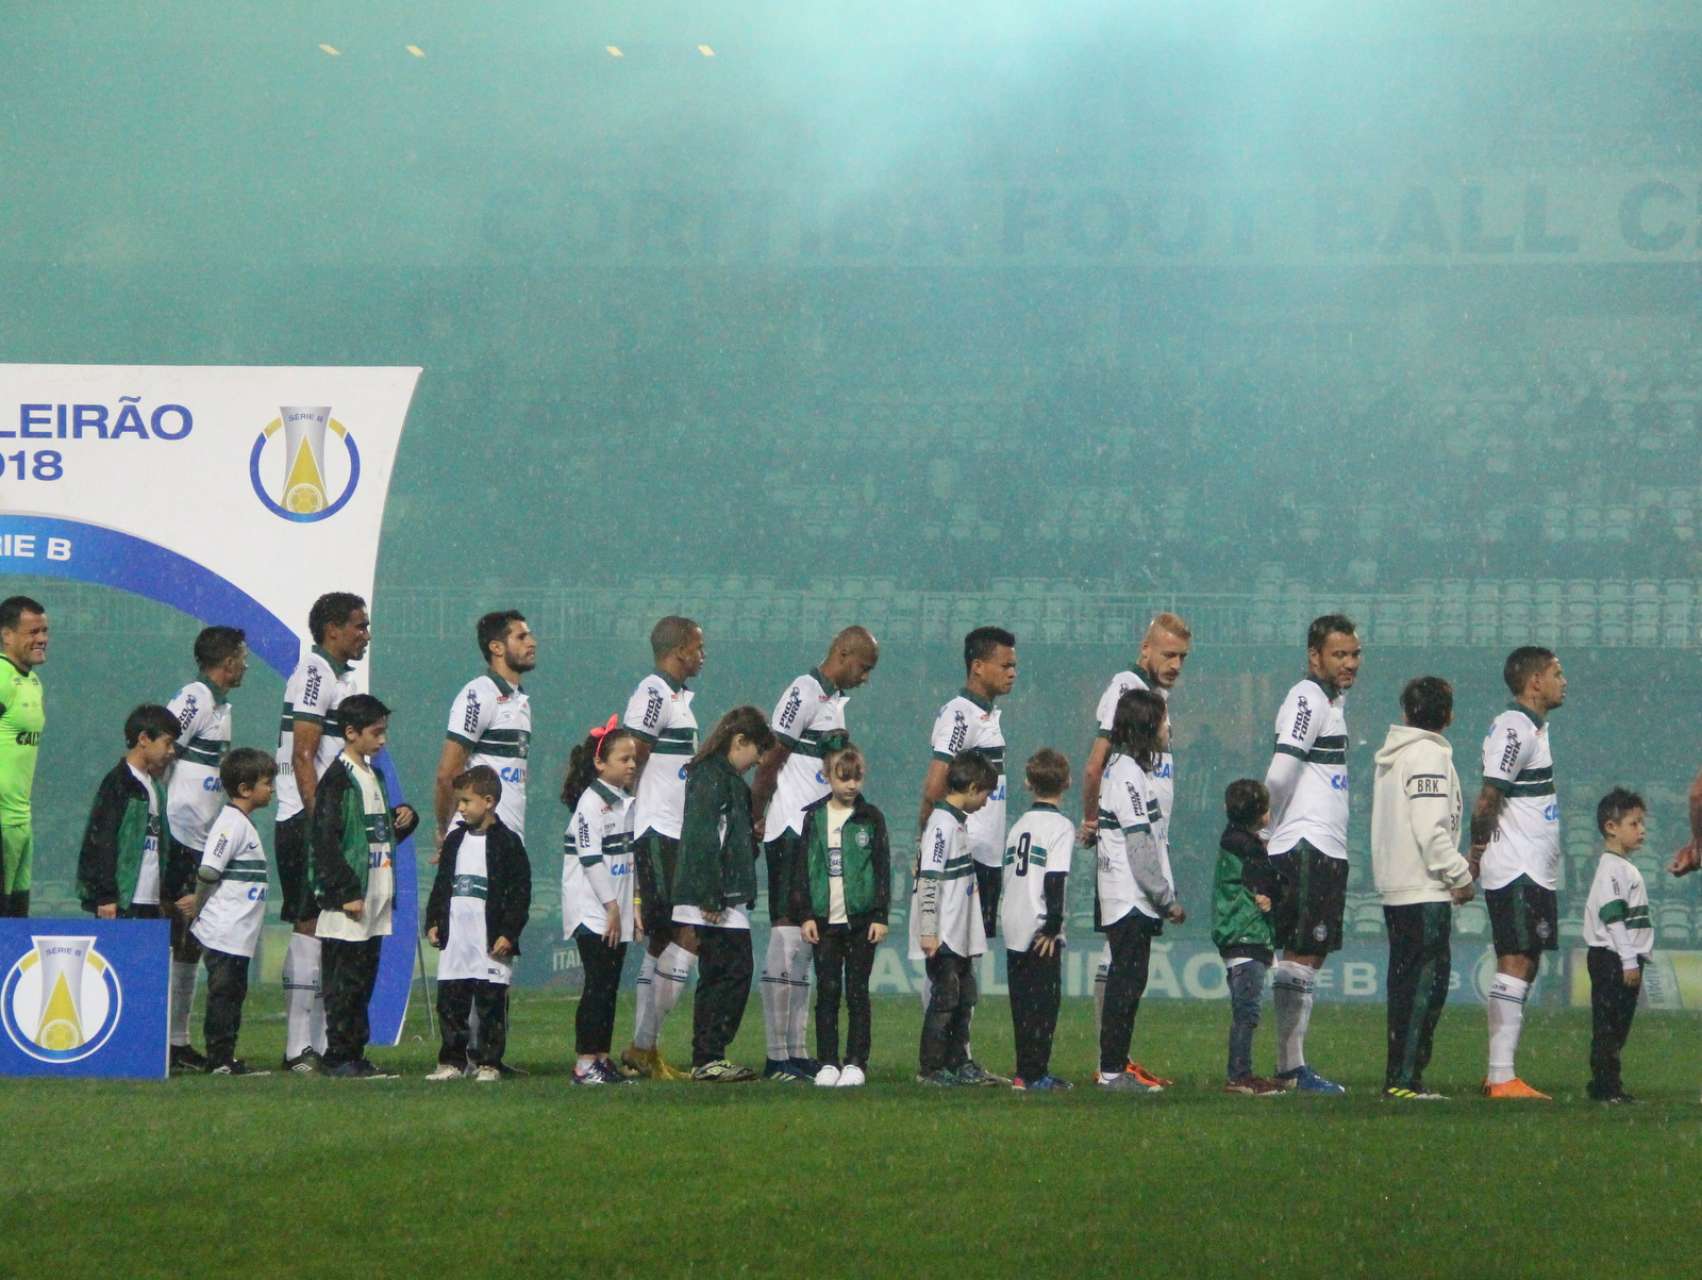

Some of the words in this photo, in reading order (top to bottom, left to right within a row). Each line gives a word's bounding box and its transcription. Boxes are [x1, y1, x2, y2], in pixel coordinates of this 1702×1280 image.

[1618, 180, 1702, 254] C
[0, 449, 64, 481] 18
[0, 534, 36, 558] IE
[46, 537, 71, 561] B
[1417, 778, 1440, 793] BRK
[1016, 832, 1031, 877] 9
[1344, 962, 1377, 996] B
